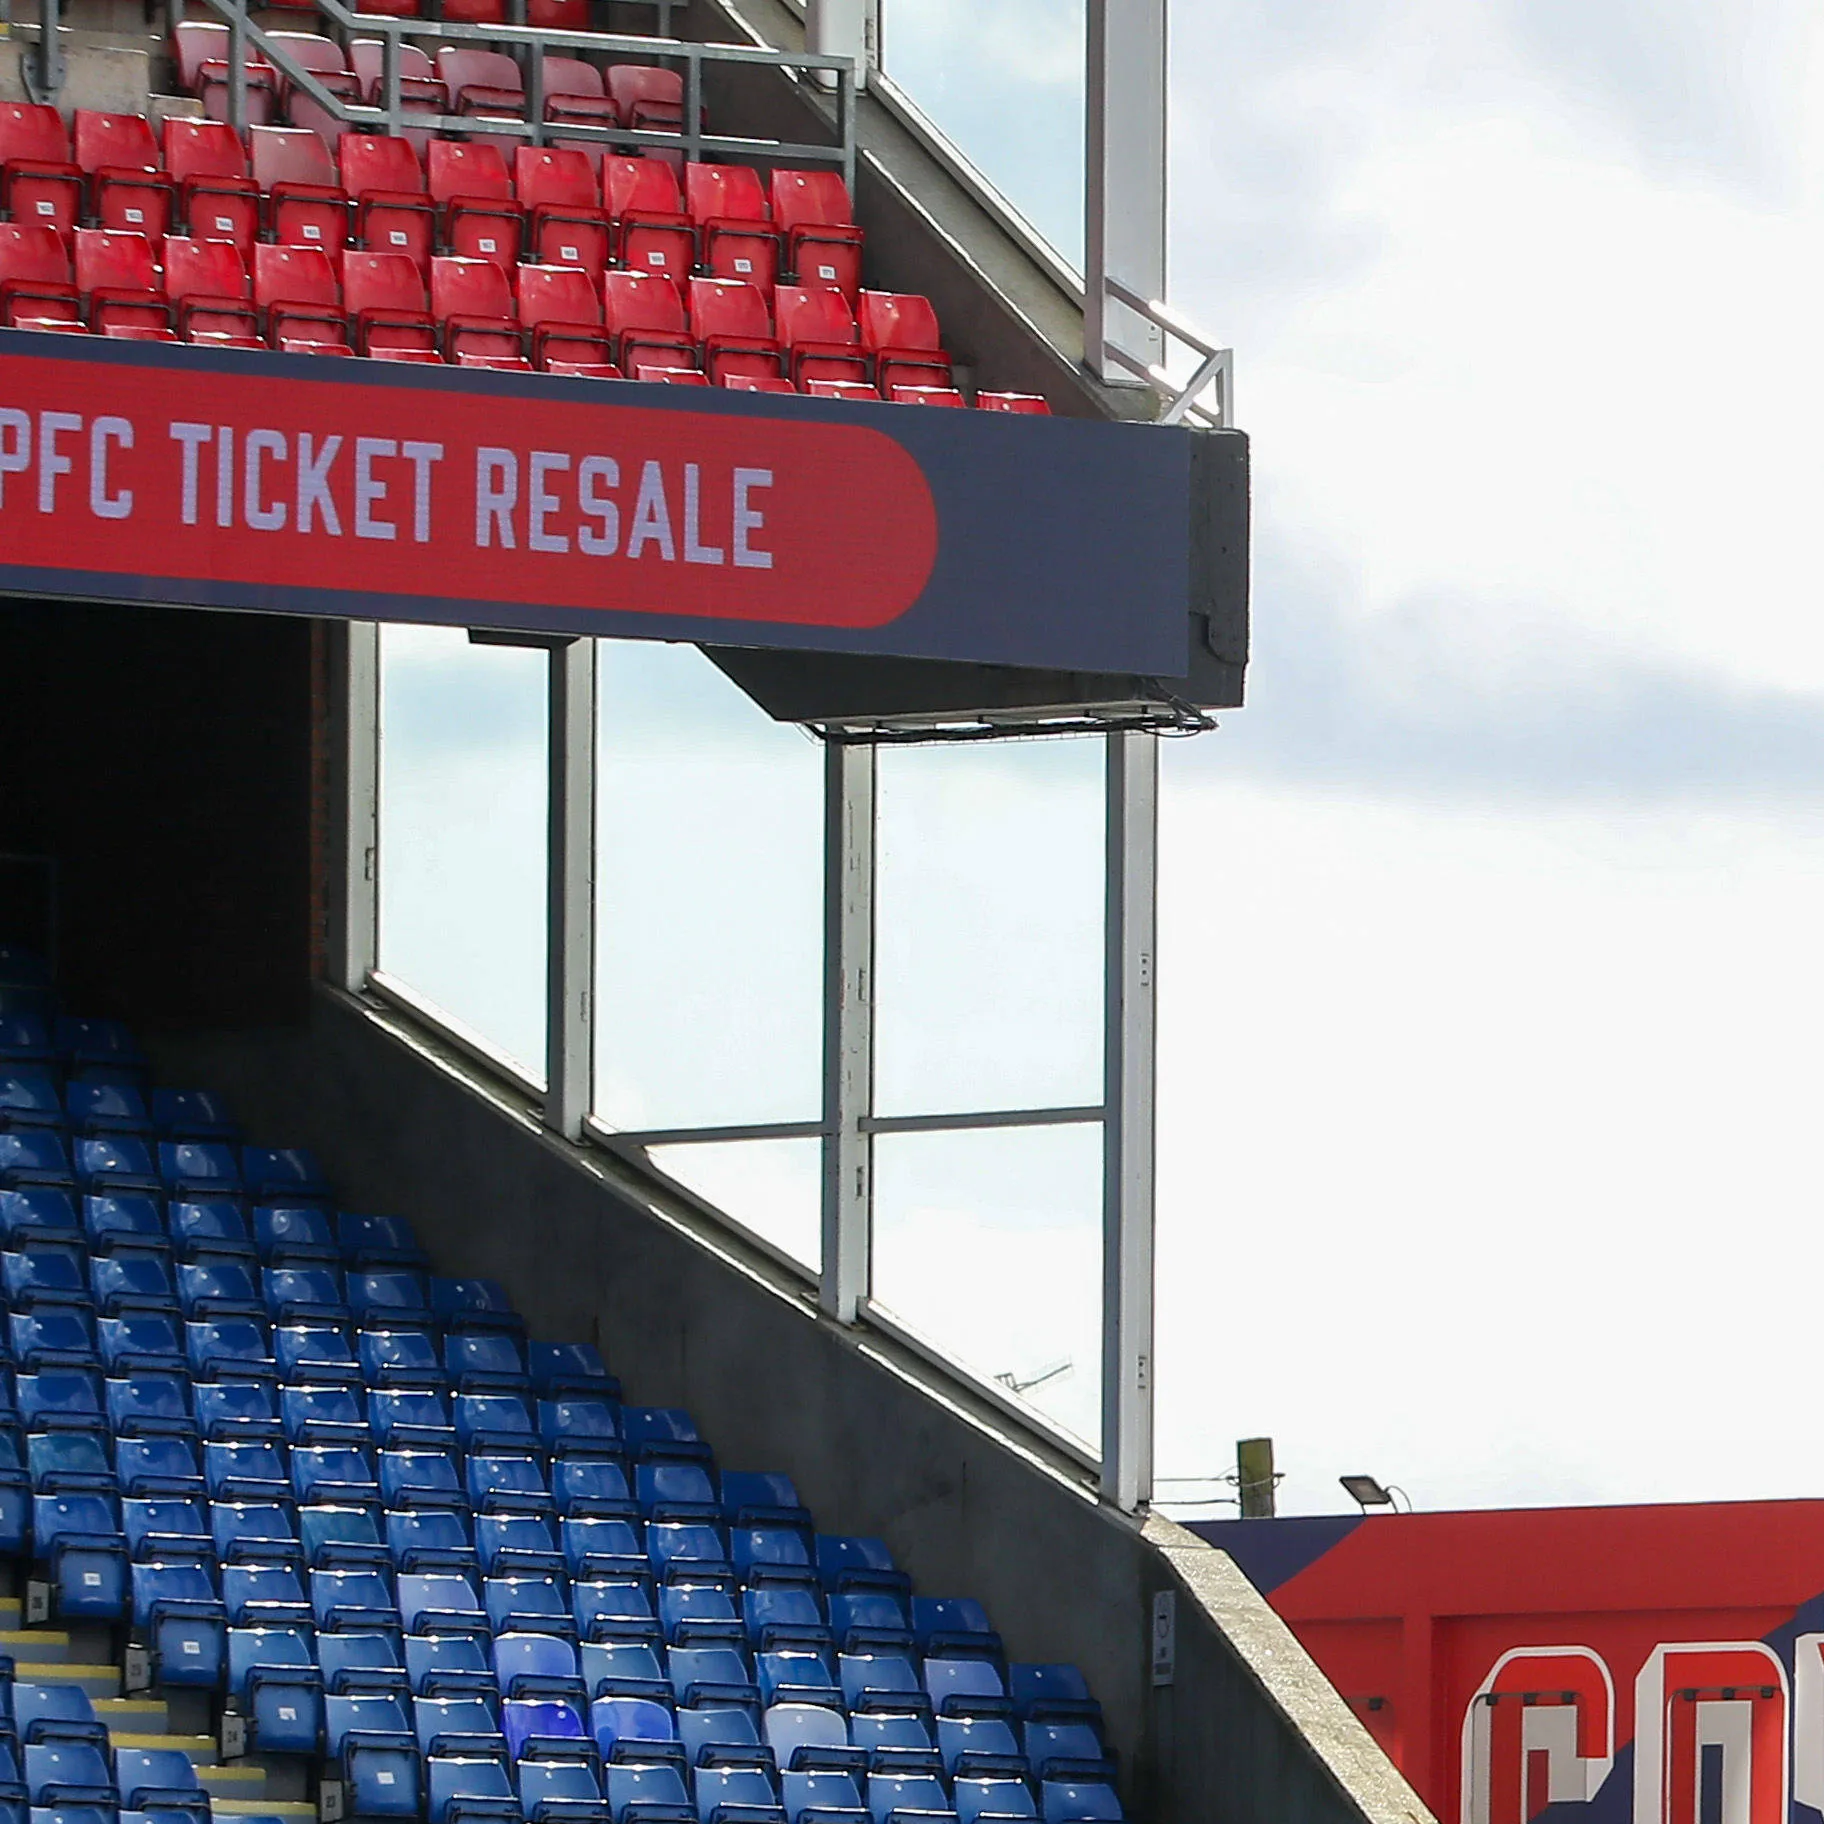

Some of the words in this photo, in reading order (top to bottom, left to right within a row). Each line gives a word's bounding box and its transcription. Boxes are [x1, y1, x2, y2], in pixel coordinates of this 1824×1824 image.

[0, 407, 134, 519] PFC
[170, 421, 444, 543] TICKET
[475, 446, 774, 569] RESALE
